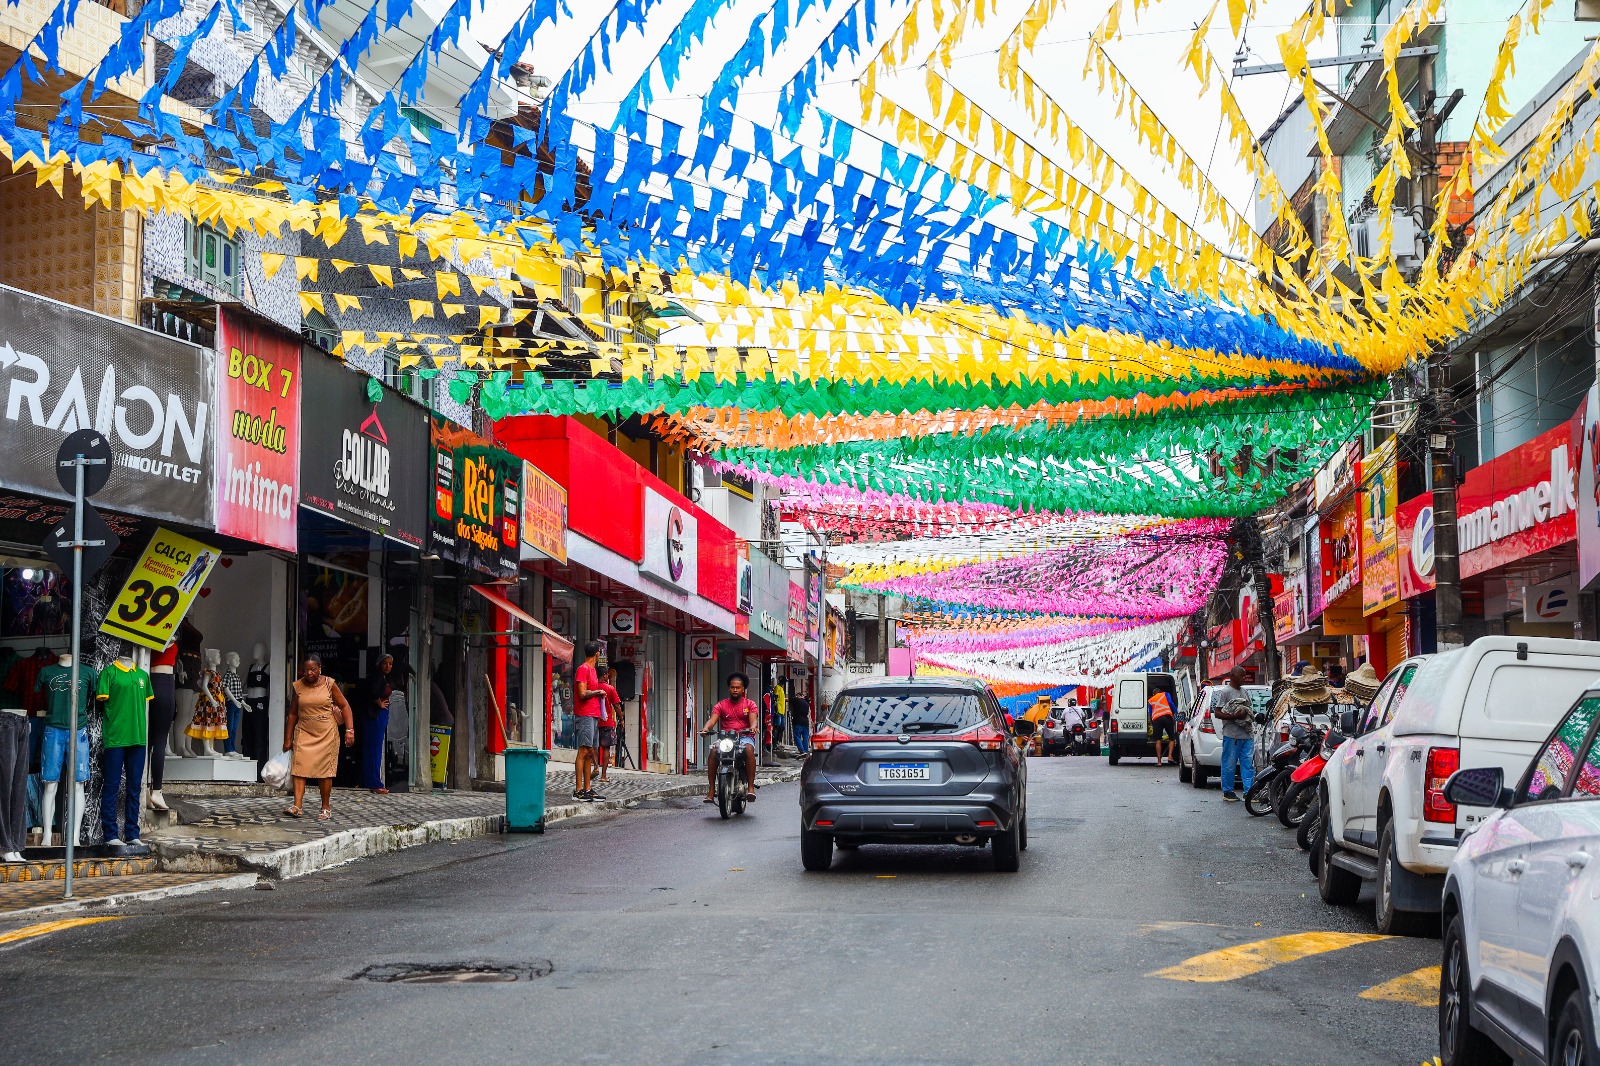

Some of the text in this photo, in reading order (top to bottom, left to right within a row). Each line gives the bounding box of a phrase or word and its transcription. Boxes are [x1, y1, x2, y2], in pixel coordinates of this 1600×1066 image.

[228, 346, 293, 398] BOX 7
[231, 406, 287, 454] moda
[140, 457, 202, 484] OUTLET
[342, 428, 390, 498] COLLAB
[224, 452, 293, 520] Intima
[463, 457, 494, 527] Rei
[457, 517, 470, 539] dos
[471, 523, 498, 552] Salgados
[145, 556, 186, 577] Feminina ou
[154, 541, 192, 565] CALÇA
[142, 563, 175, 580] Masculina
[884, 768, 925, 779] TGS1G51
